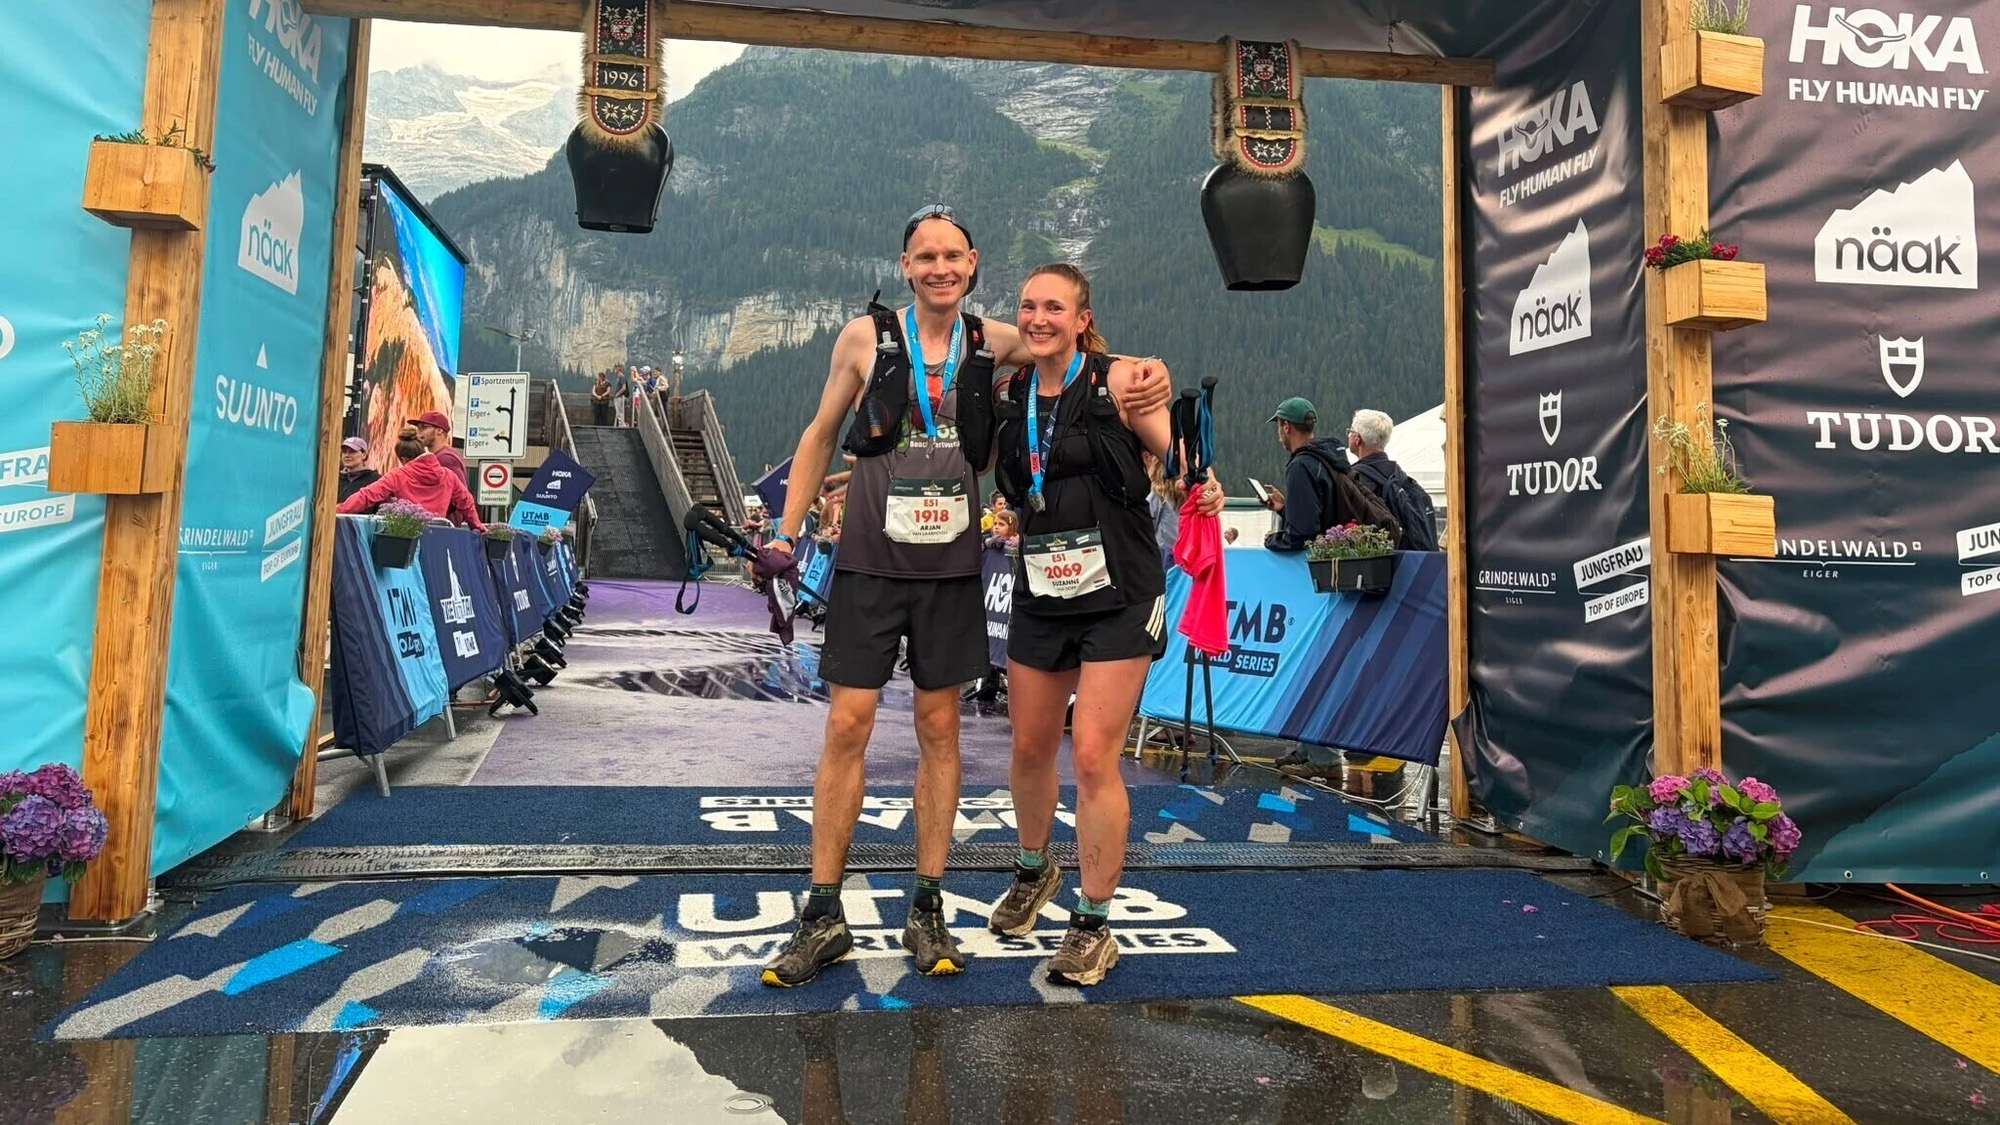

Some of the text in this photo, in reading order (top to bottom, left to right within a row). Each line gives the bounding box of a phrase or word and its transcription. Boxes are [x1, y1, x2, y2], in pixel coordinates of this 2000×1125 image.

[1789, 4, 1984, 74] HOKA
[248, 32, 318, 117] FLY HUMAN FLY
[603, 70, 638, 87] 1996
[1788, 78, 1986, 110] FLY HUMAN FLY
[1498, 80, 1599, 177] HOKA
[1500, 146, 1599, 208] FLY HUMAN FLY
[248, 218, 293, 280] näak
[1835, 226, 1962, 275] näak
[1519, 293, 1582, 342] näak
[481, 377, 525, 385] Sportzentrum
[216, 375, 297, 435] SUUNTO
[1806, 411, 2000, 453] TUDOR
[552, 470, 572, 478] HOKA
[1507, 456, 1602, 495] TUDOR
[924, 499, 938, 507] E51
[0, 504, 66, 526] UROPE
[267, 502, 303, 539] JUNGFRAU
[522, 511, 550, 521] UTMB
[914, 509, 949, 523] 1918
[1052, 553, 1066, 562] E51
[1774, 538, 1907, 558] INDELWALD
[202, 562, 217, 570] EIGER
[1044, 563, 1082, 579] 2069
[1581, 545, 1644, 582] JUNGFRAU
[1052, 578, 1079, 587] SUZANNE
[1479, 570, 1550, 587] GRINDELWALD
[1803, 569, 1839, 579] EIGER
[1968, 573, 1993, 588] TOP
[1505, 597, 1523, 605] EIGER
[1588, 588, 1644, 616] TOP OF EUROPE
[1235, 654, 1275, 672] SERIES
[996, 932, 1208, 951] SEIES
